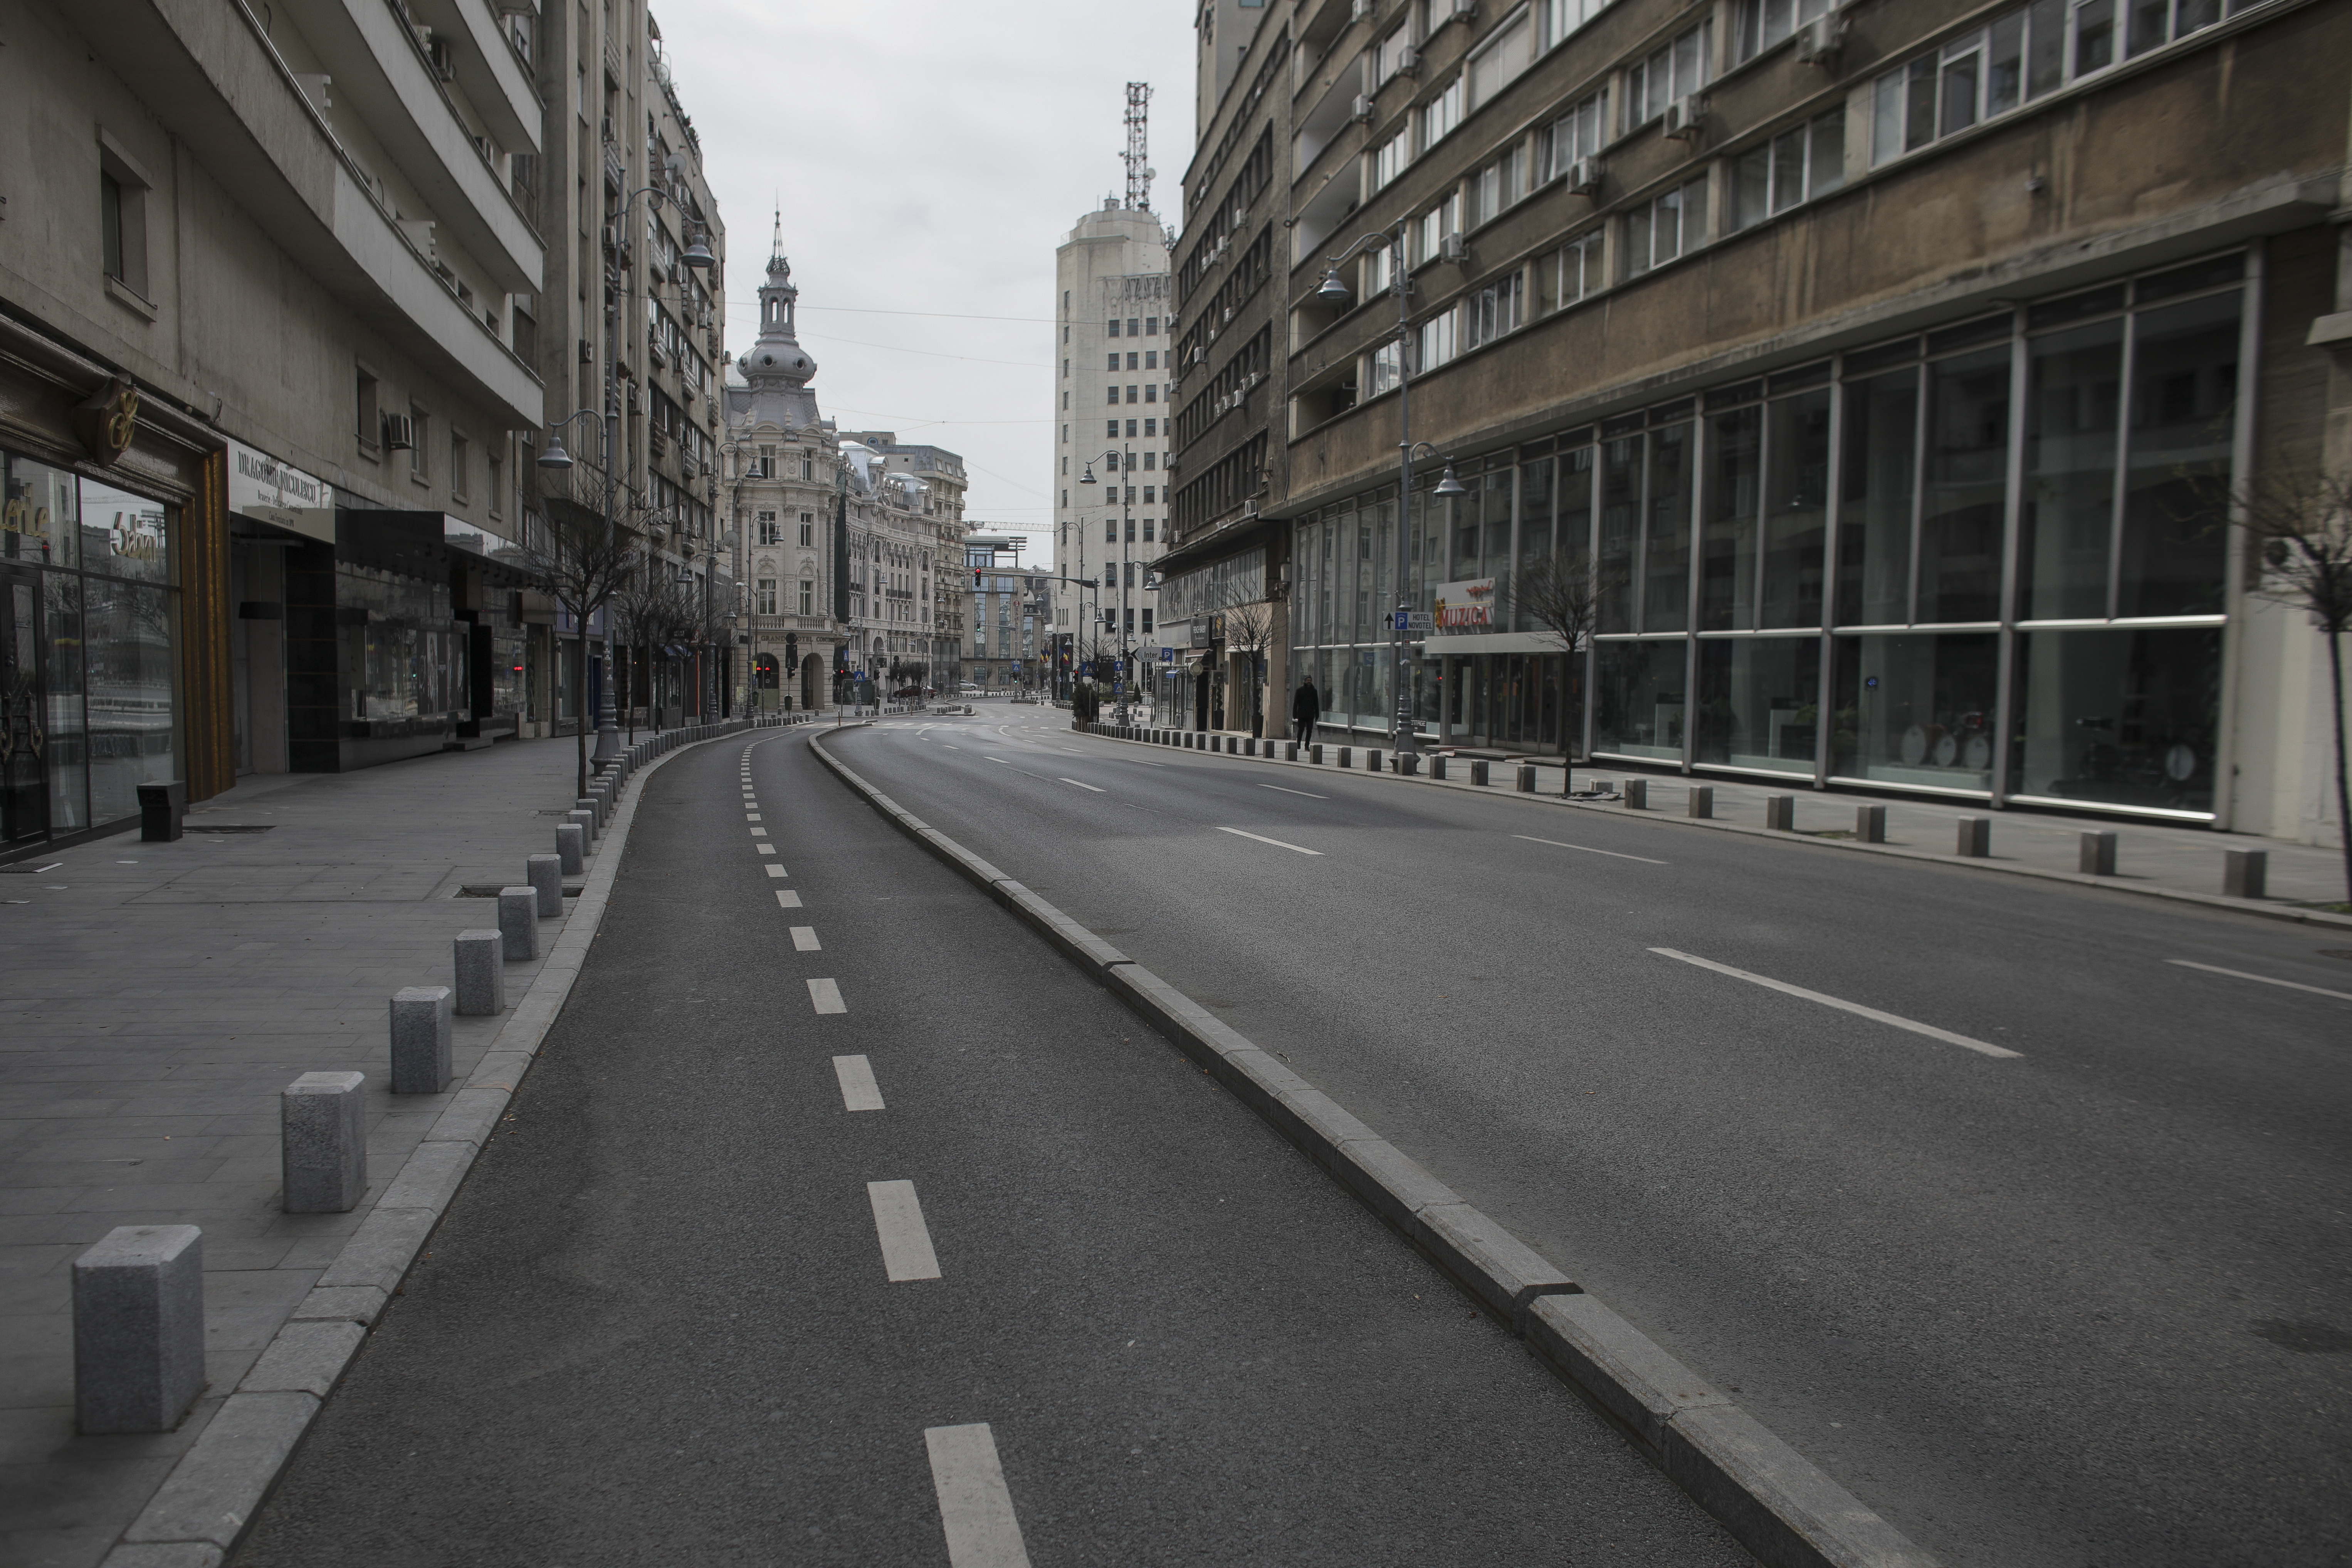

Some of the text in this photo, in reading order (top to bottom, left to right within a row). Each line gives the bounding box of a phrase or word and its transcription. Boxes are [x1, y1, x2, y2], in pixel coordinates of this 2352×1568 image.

[238, 450, 316, 503] DRAGOMIR NICULESCU
[1440, 606, 1489, 626] MUZICA
